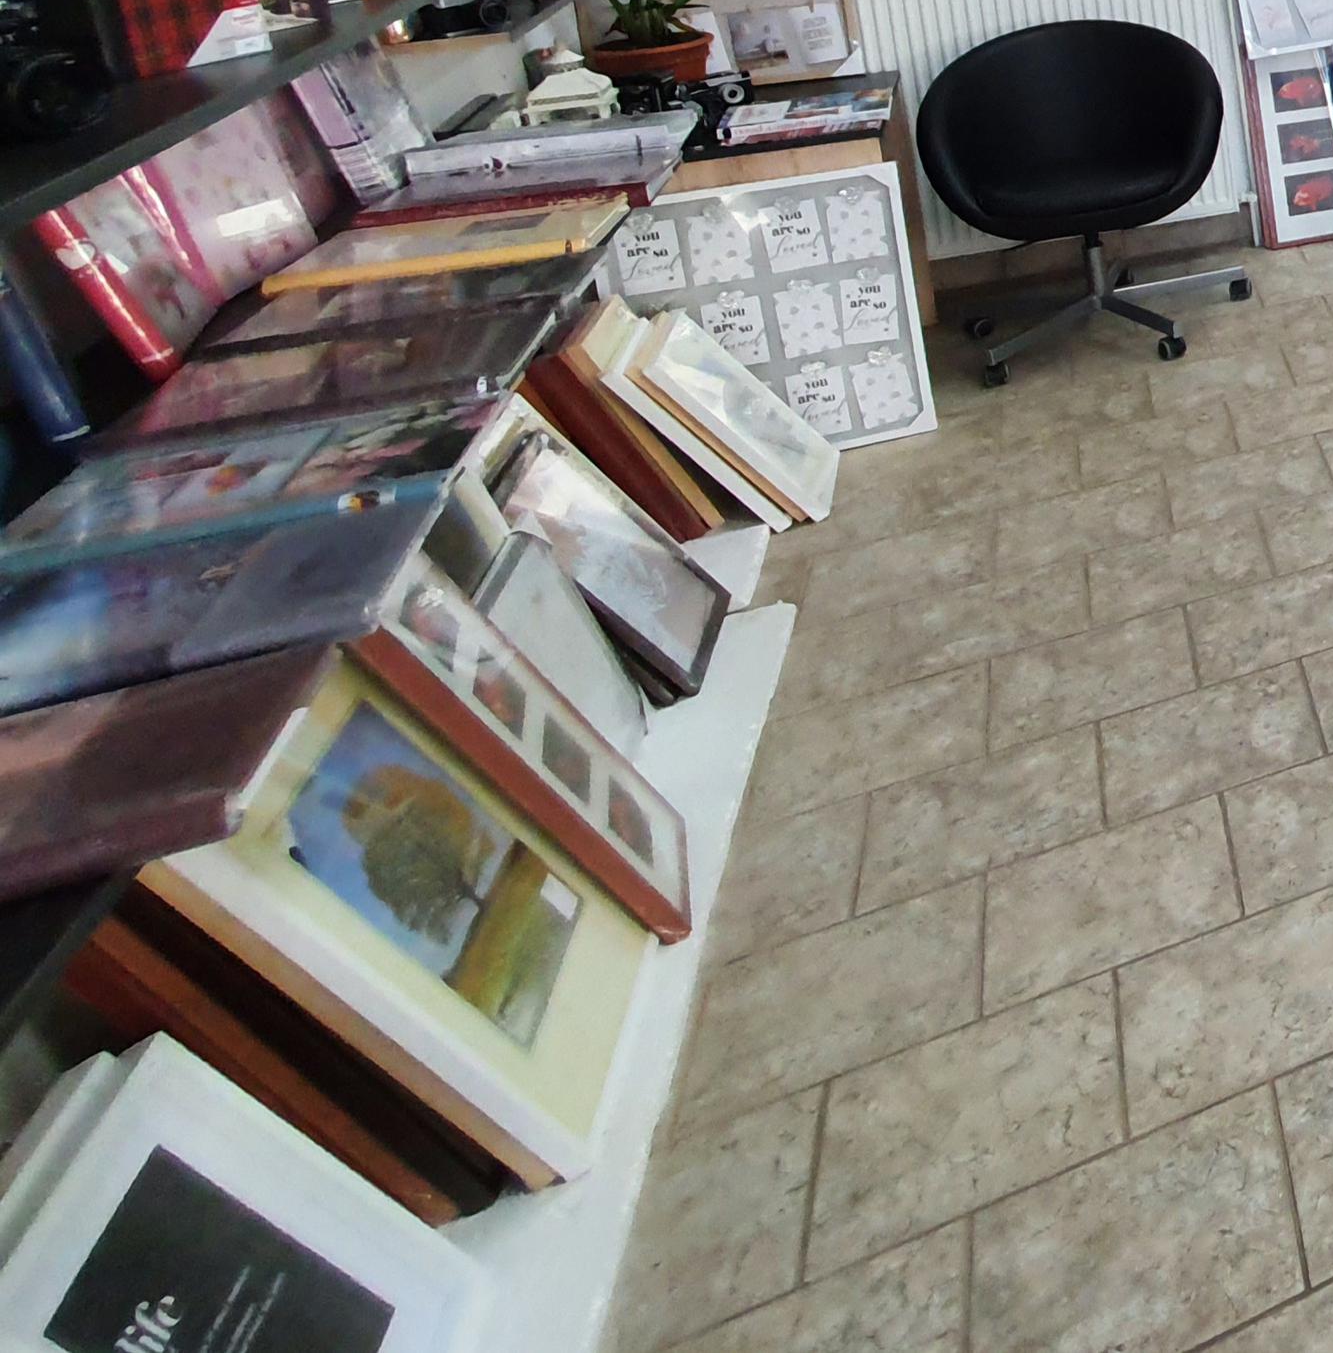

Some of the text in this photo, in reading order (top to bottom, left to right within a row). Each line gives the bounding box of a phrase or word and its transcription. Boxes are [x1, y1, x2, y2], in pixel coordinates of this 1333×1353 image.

[777, 210, 803, 223] you
[634, 230, 661, 246] you
[771, 224, 811, 238] are so
[626, 245, 669, 258] are so
[858, 284, 881, 298] you
[849, 297, 887, 310] are so
[720, 307, 746, 323] you
[712, 321, 753, 335] are so
[804, 377, 829, 392] you
[797, 391, 836, 405] are so
